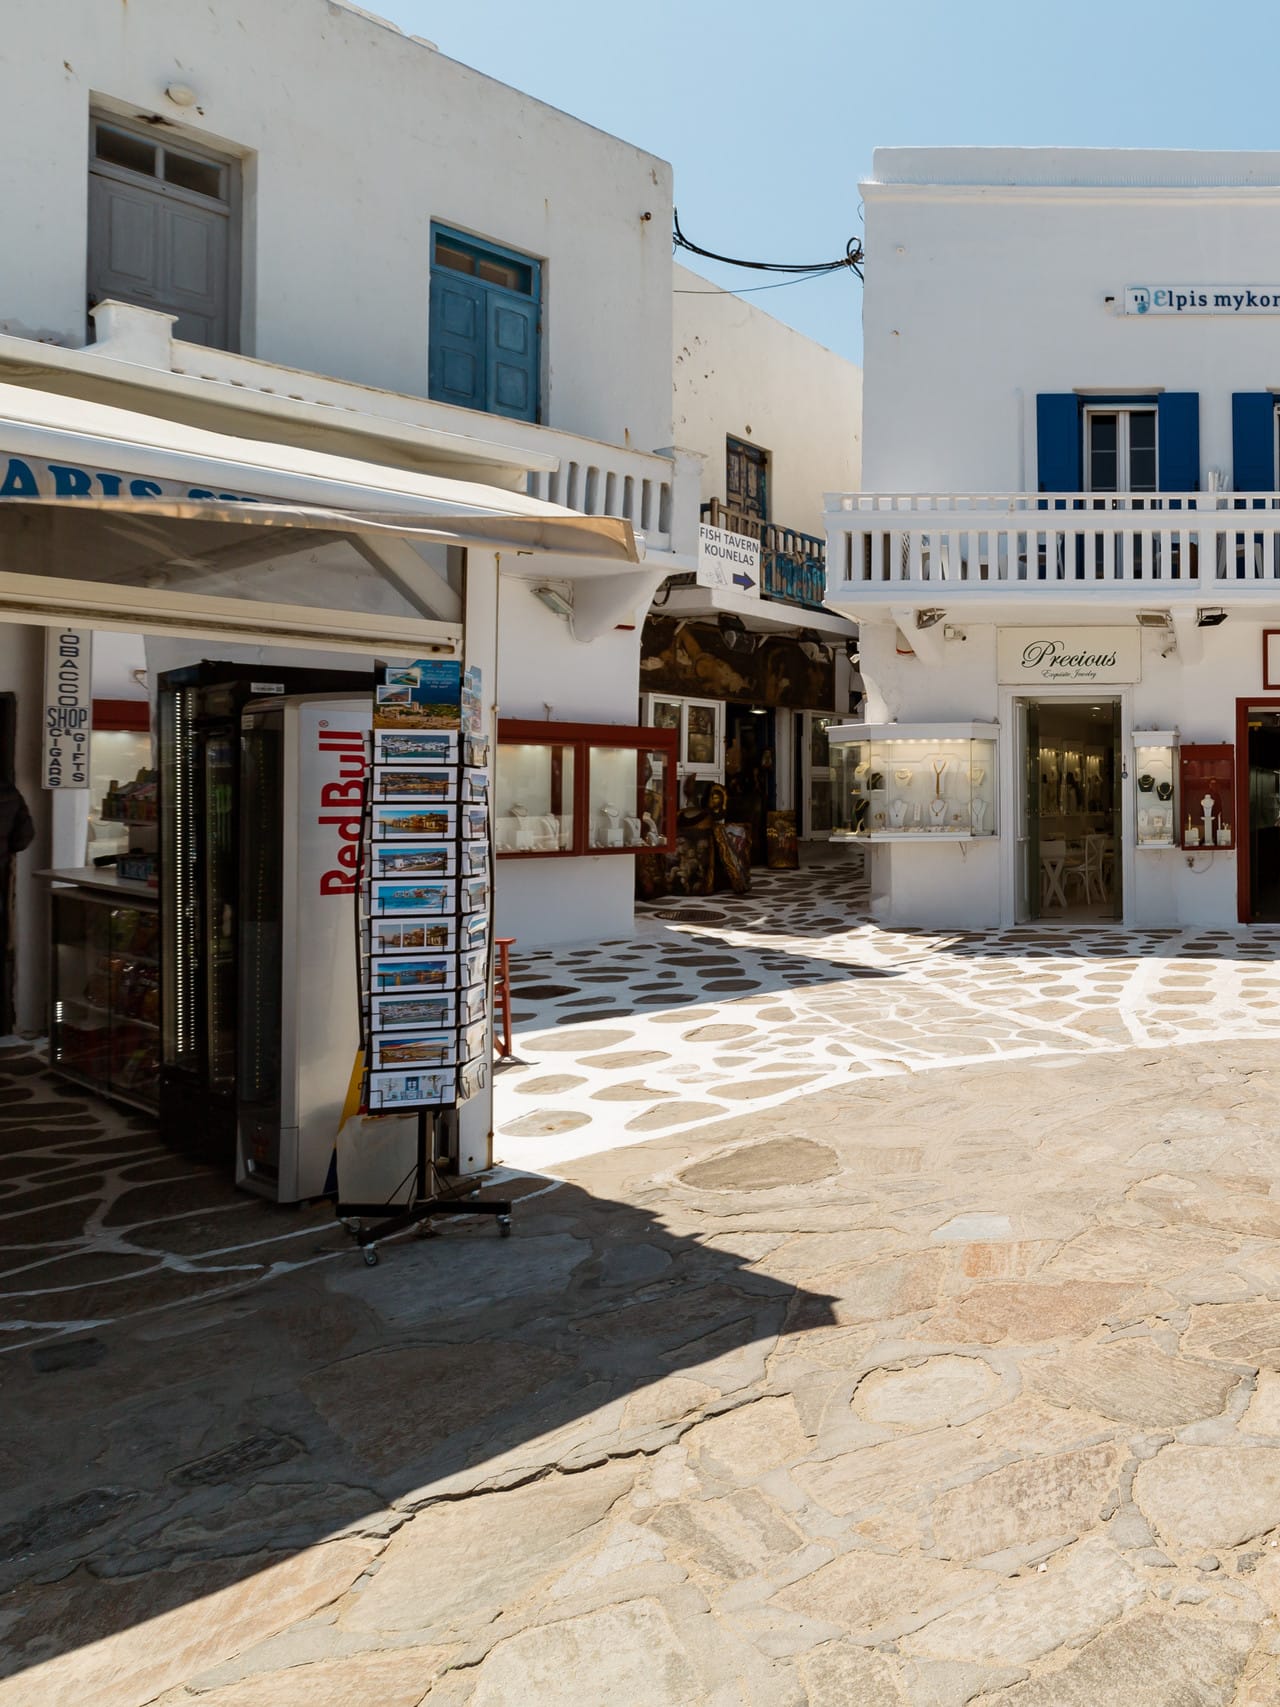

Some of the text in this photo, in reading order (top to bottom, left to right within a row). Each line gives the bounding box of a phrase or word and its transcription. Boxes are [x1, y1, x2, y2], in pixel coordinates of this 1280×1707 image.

[700, 527, 759, 554] FISH TAVERN
[705, 543, 754, 566] KOUNELAS
[58, 627, 80, 706] OBACCO
[1021, 640, 1117, 668] Precious
[48, 707, 87, 728] SHOP
[48, 728, 62, 786] CIGARS
[72, 733, 85, 782] GIFTS
